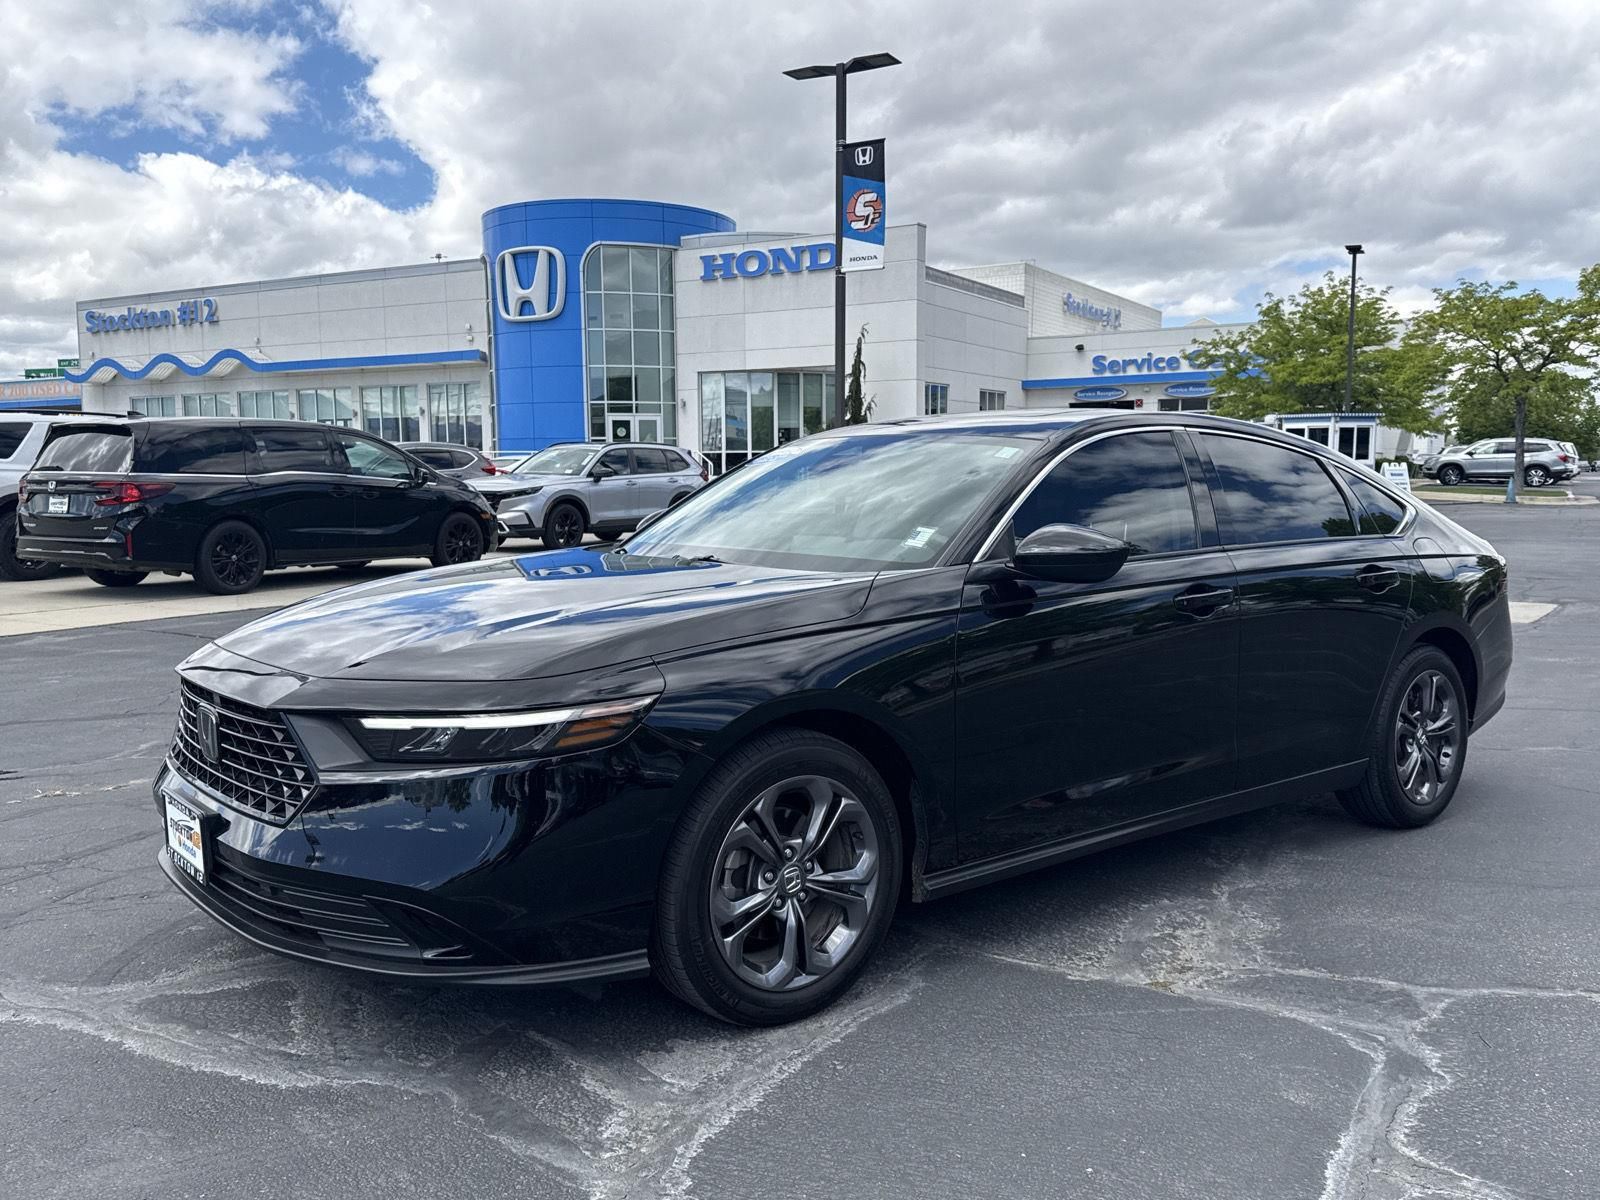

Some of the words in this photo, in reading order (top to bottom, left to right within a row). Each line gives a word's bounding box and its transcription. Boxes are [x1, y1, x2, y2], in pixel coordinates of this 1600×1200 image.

[700, 242, 837, 281] HOND
[849, 254, 878, 263] HONDA
[85, 306, 173, 333] Stockton
[177, 298, 216, 325] #12
[1091, 351, 1181, 375] Service
